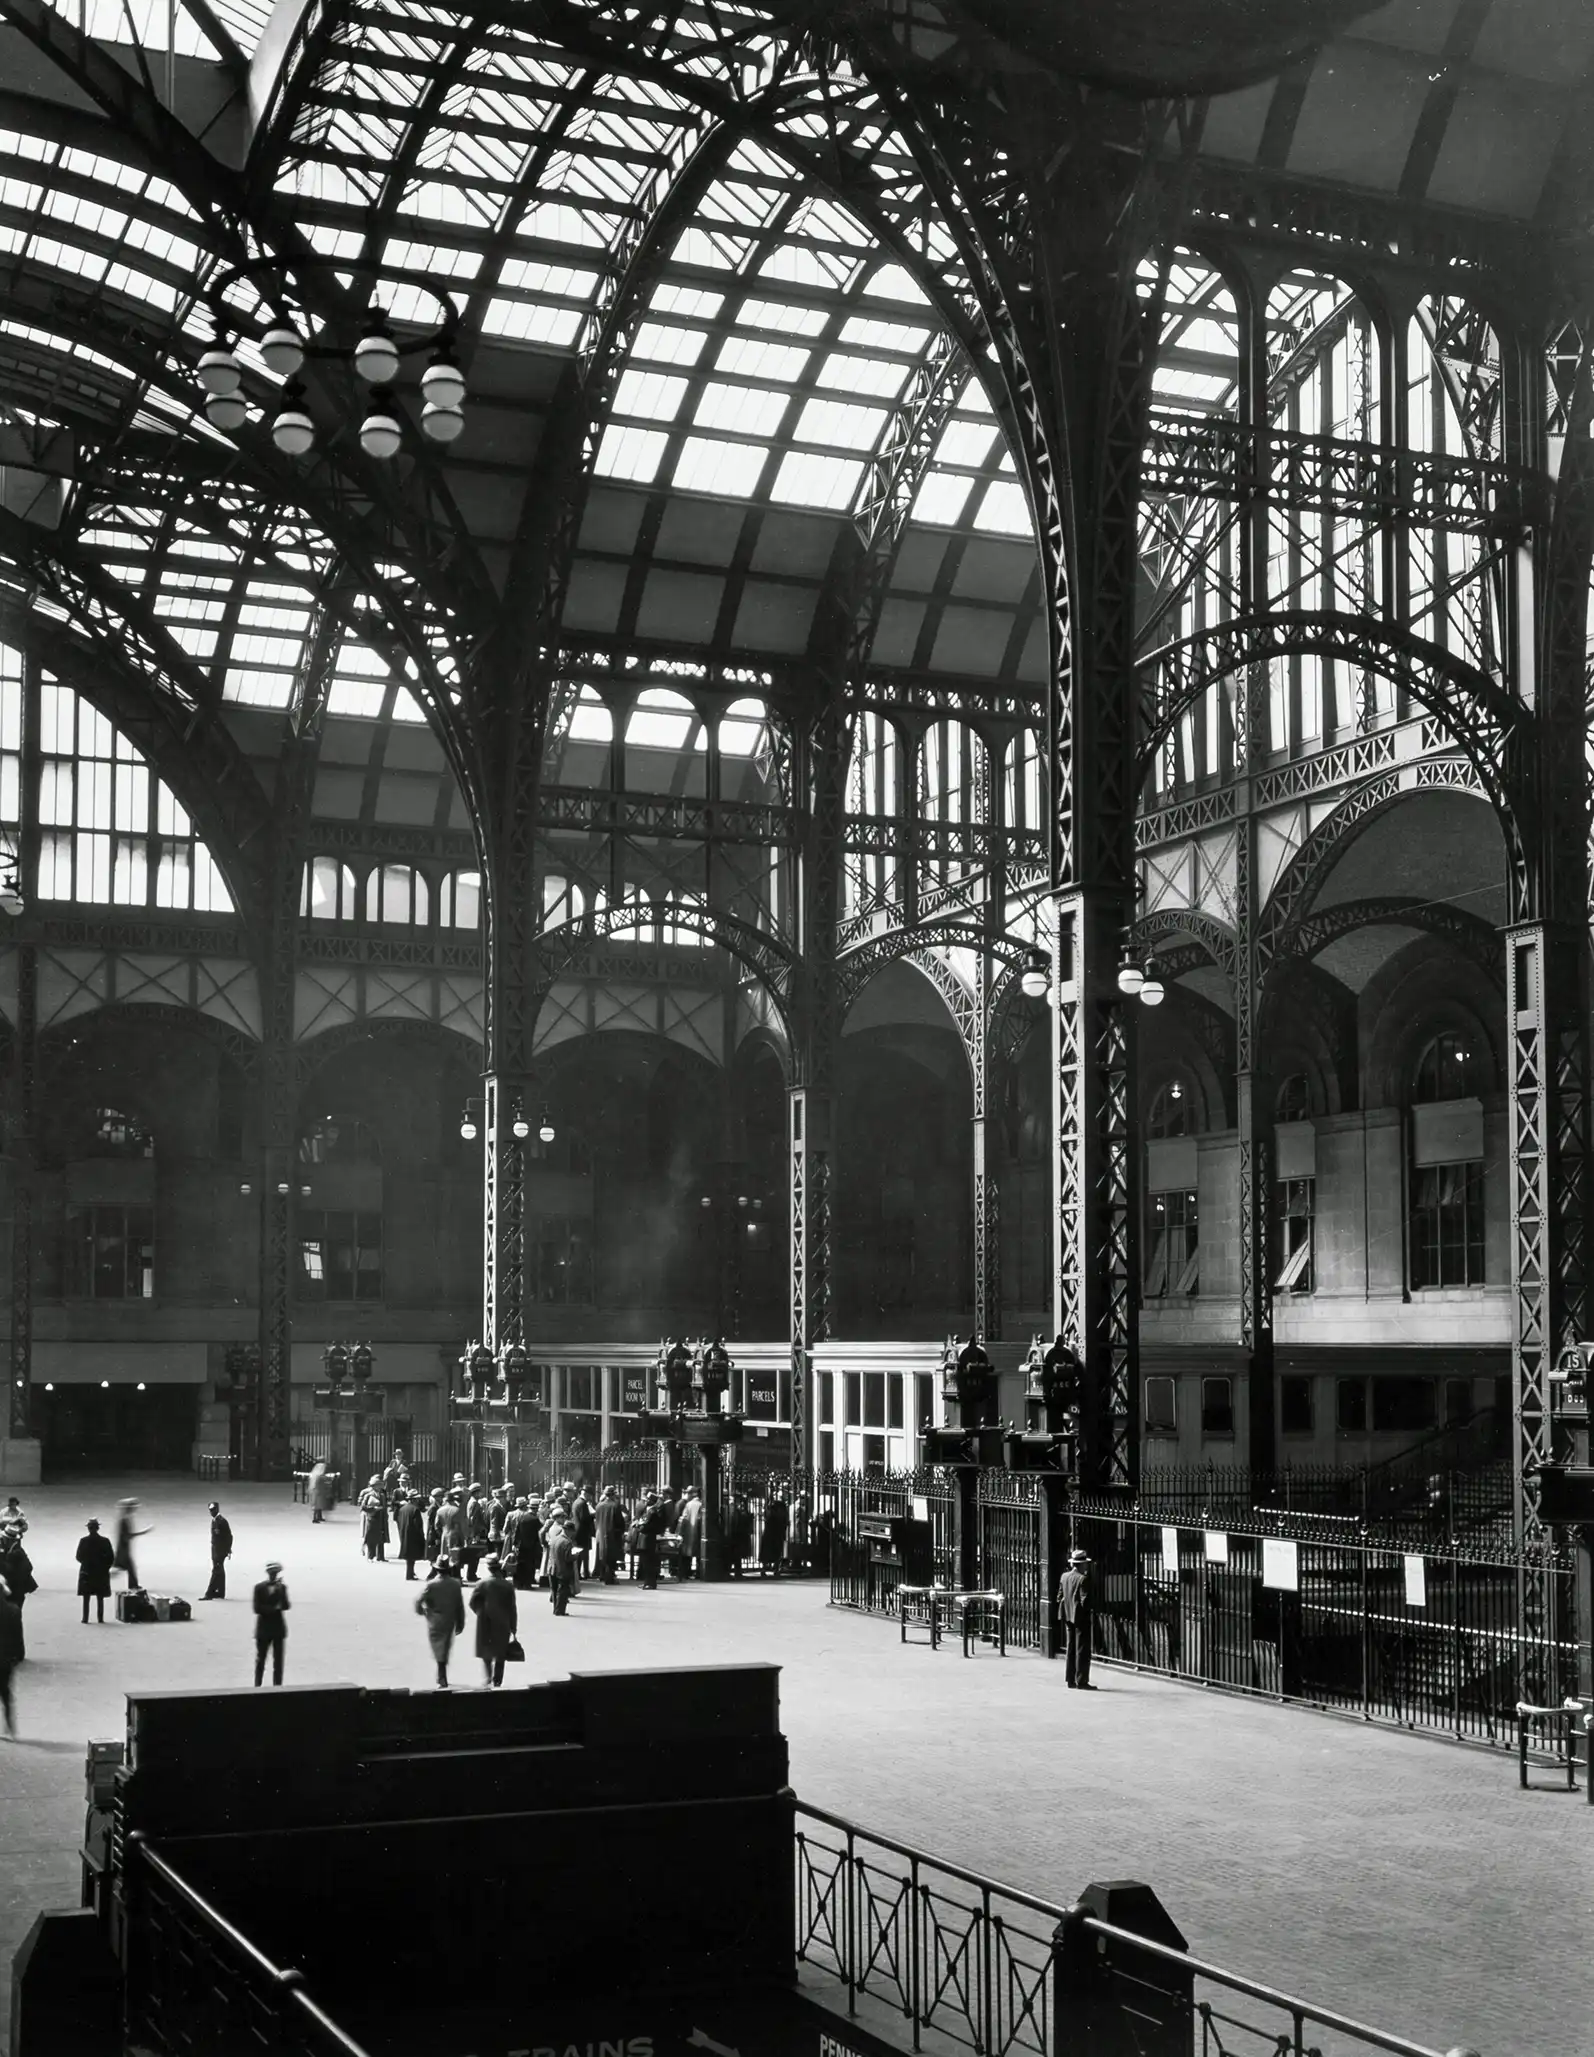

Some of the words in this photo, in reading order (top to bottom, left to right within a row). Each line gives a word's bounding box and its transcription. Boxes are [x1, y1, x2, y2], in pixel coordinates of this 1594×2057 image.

[1567, 1354, 1580, 1368] 15
[627, 1379, 644, 1390] PARCEL
[751, 1390, 775, 1403] PARCELS
[507, 2036, 654, 2057] AINS
